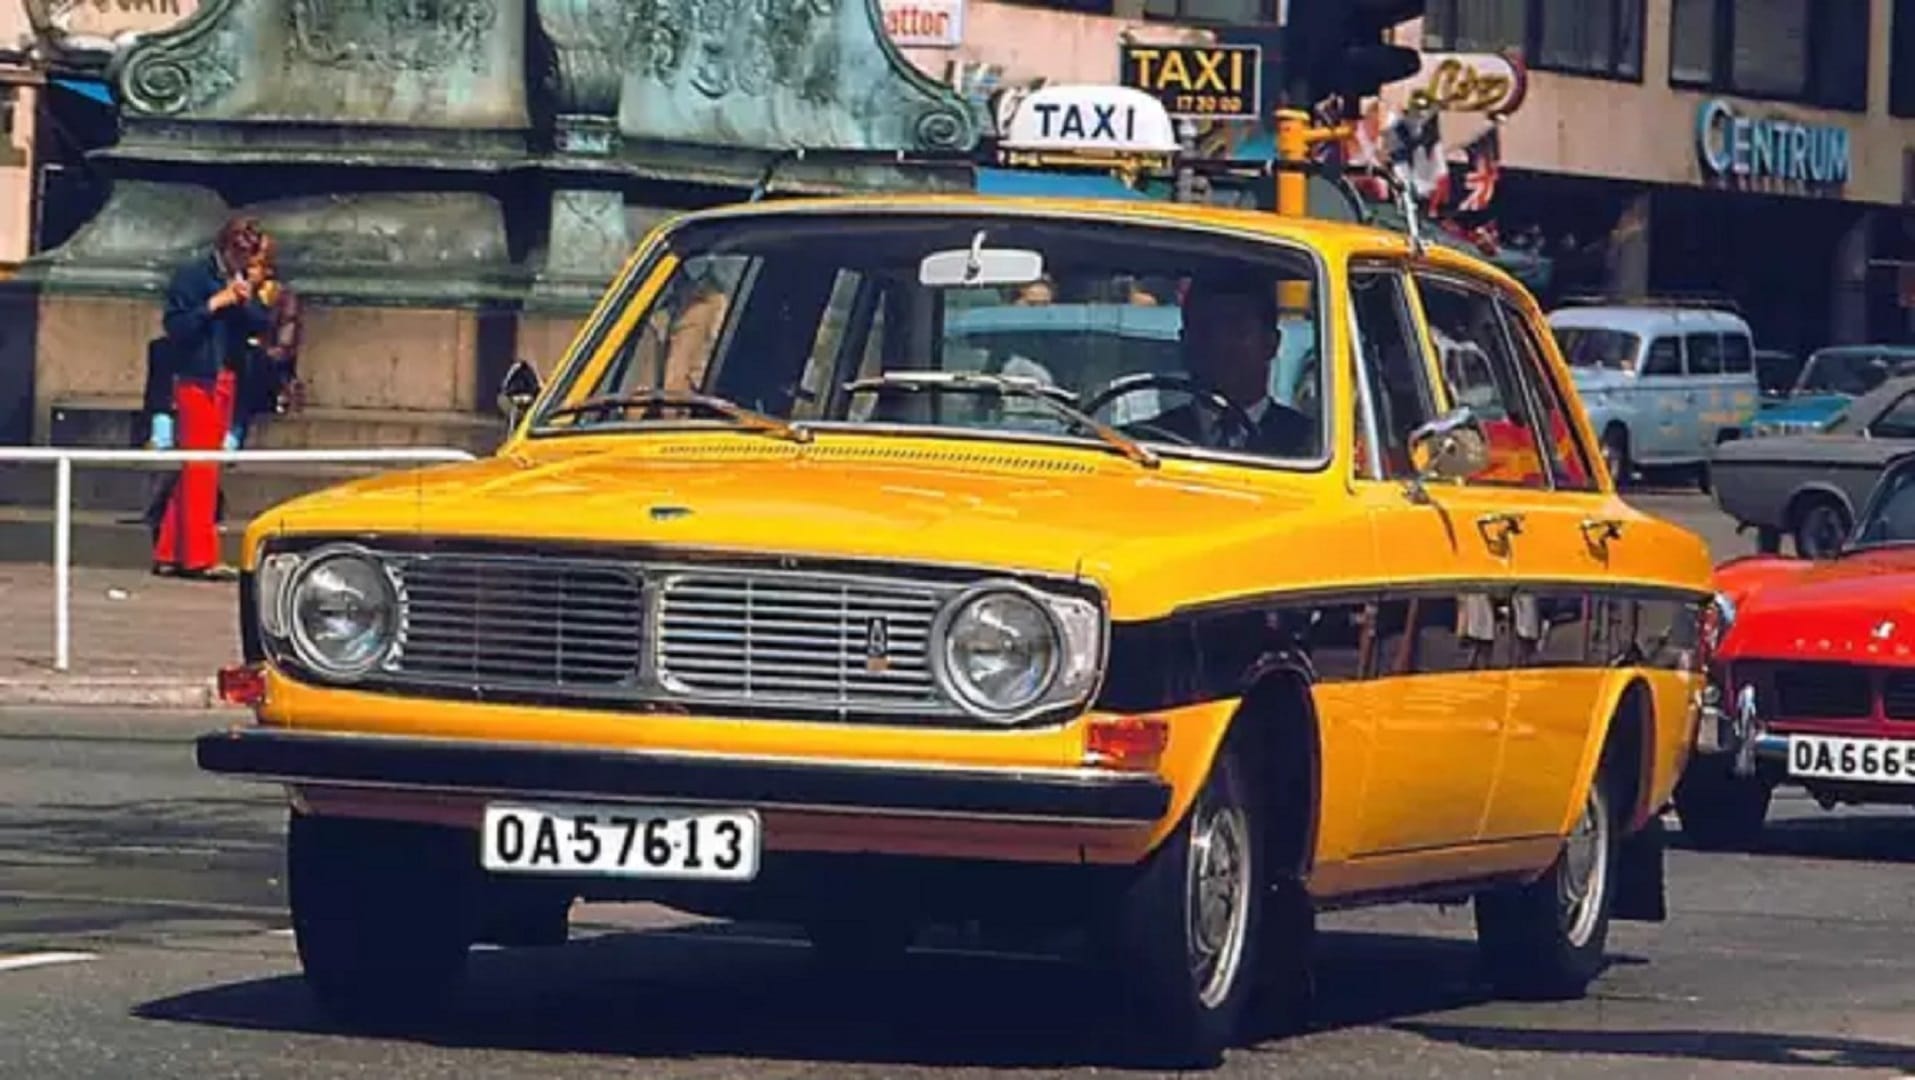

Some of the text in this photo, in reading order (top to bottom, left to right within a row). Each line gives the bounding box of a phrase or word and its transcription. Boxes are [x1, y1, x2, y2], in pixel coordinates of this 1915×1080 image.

[1130, 50, 1243, 92] TAXI
[1034, 103, 1135, 141] TAXI
[1697, 100, 1853, 181] CENTRUM
